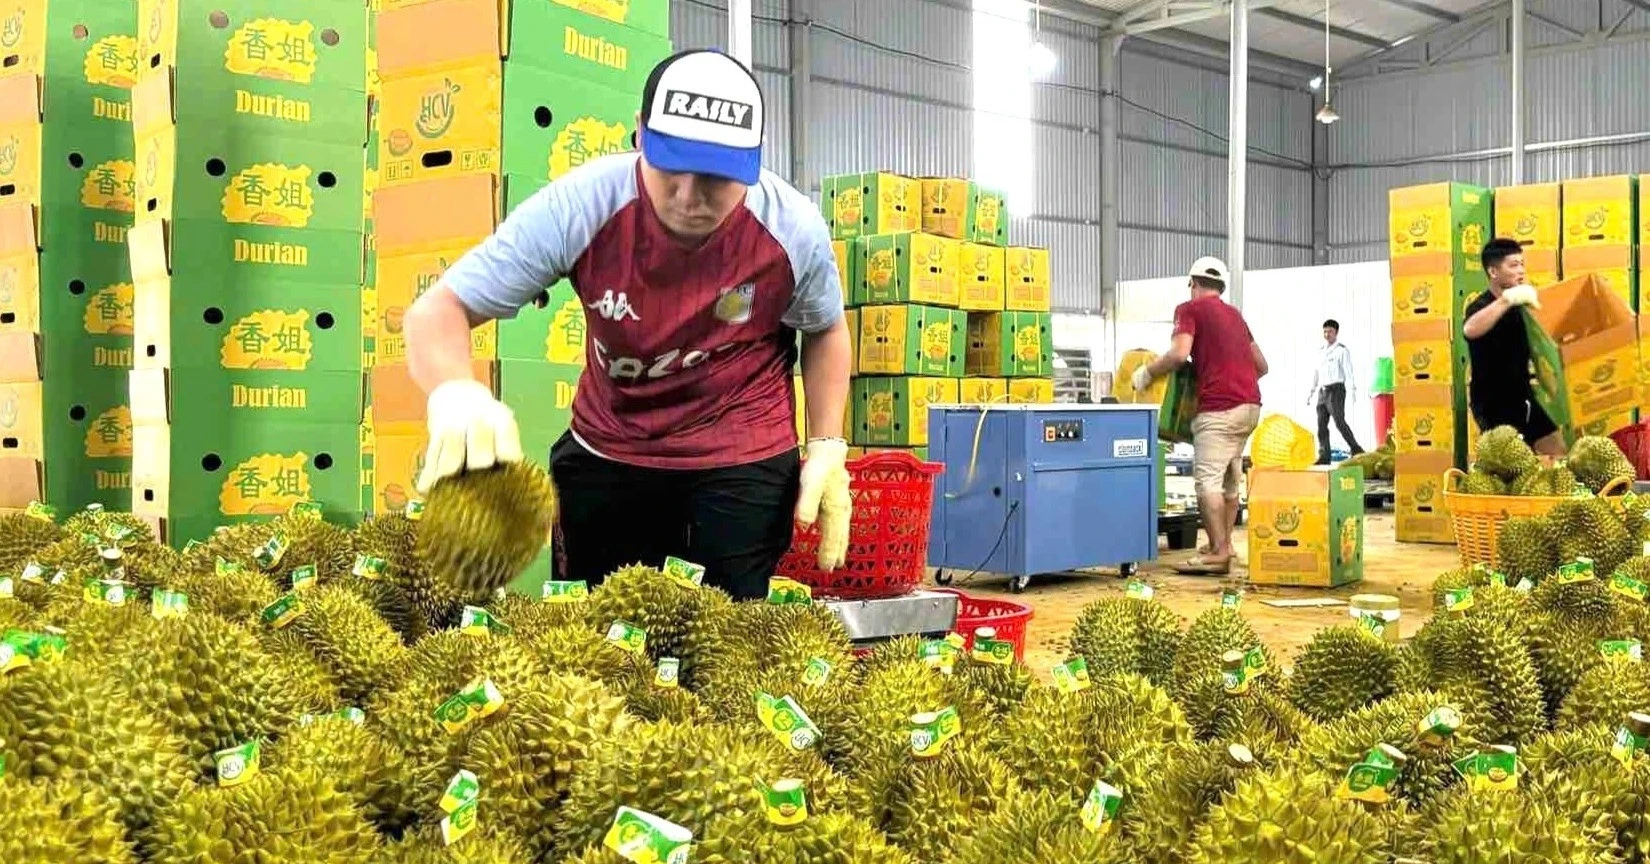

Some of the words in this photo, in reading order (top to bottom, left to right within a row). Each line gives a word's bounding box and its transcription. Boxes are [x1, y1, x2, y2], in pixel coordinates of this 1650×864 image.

[240, 27, 310, 66] 香姐
[564, 25, 628, 70] Durian
[94, 96, 132, 121] Duri
[236, 89, 310, 122] Durian
[421, 92, 452, 122] HCV
[668, 92, 749, 125] RAILY
[236, 173, 307, 210] 香姐
[234, 238, 308, 266] Durian
[96, 292, 132, 320] 香
[235, 322, 306, 355] 香姐
[560, 306, 586, 347] 香
[95, 346, 132, 367] Duri
[232, 384, 306, 408] Durian
[97, 415, 132, 443] 香
[234, 465, 306, 497] 香姐
